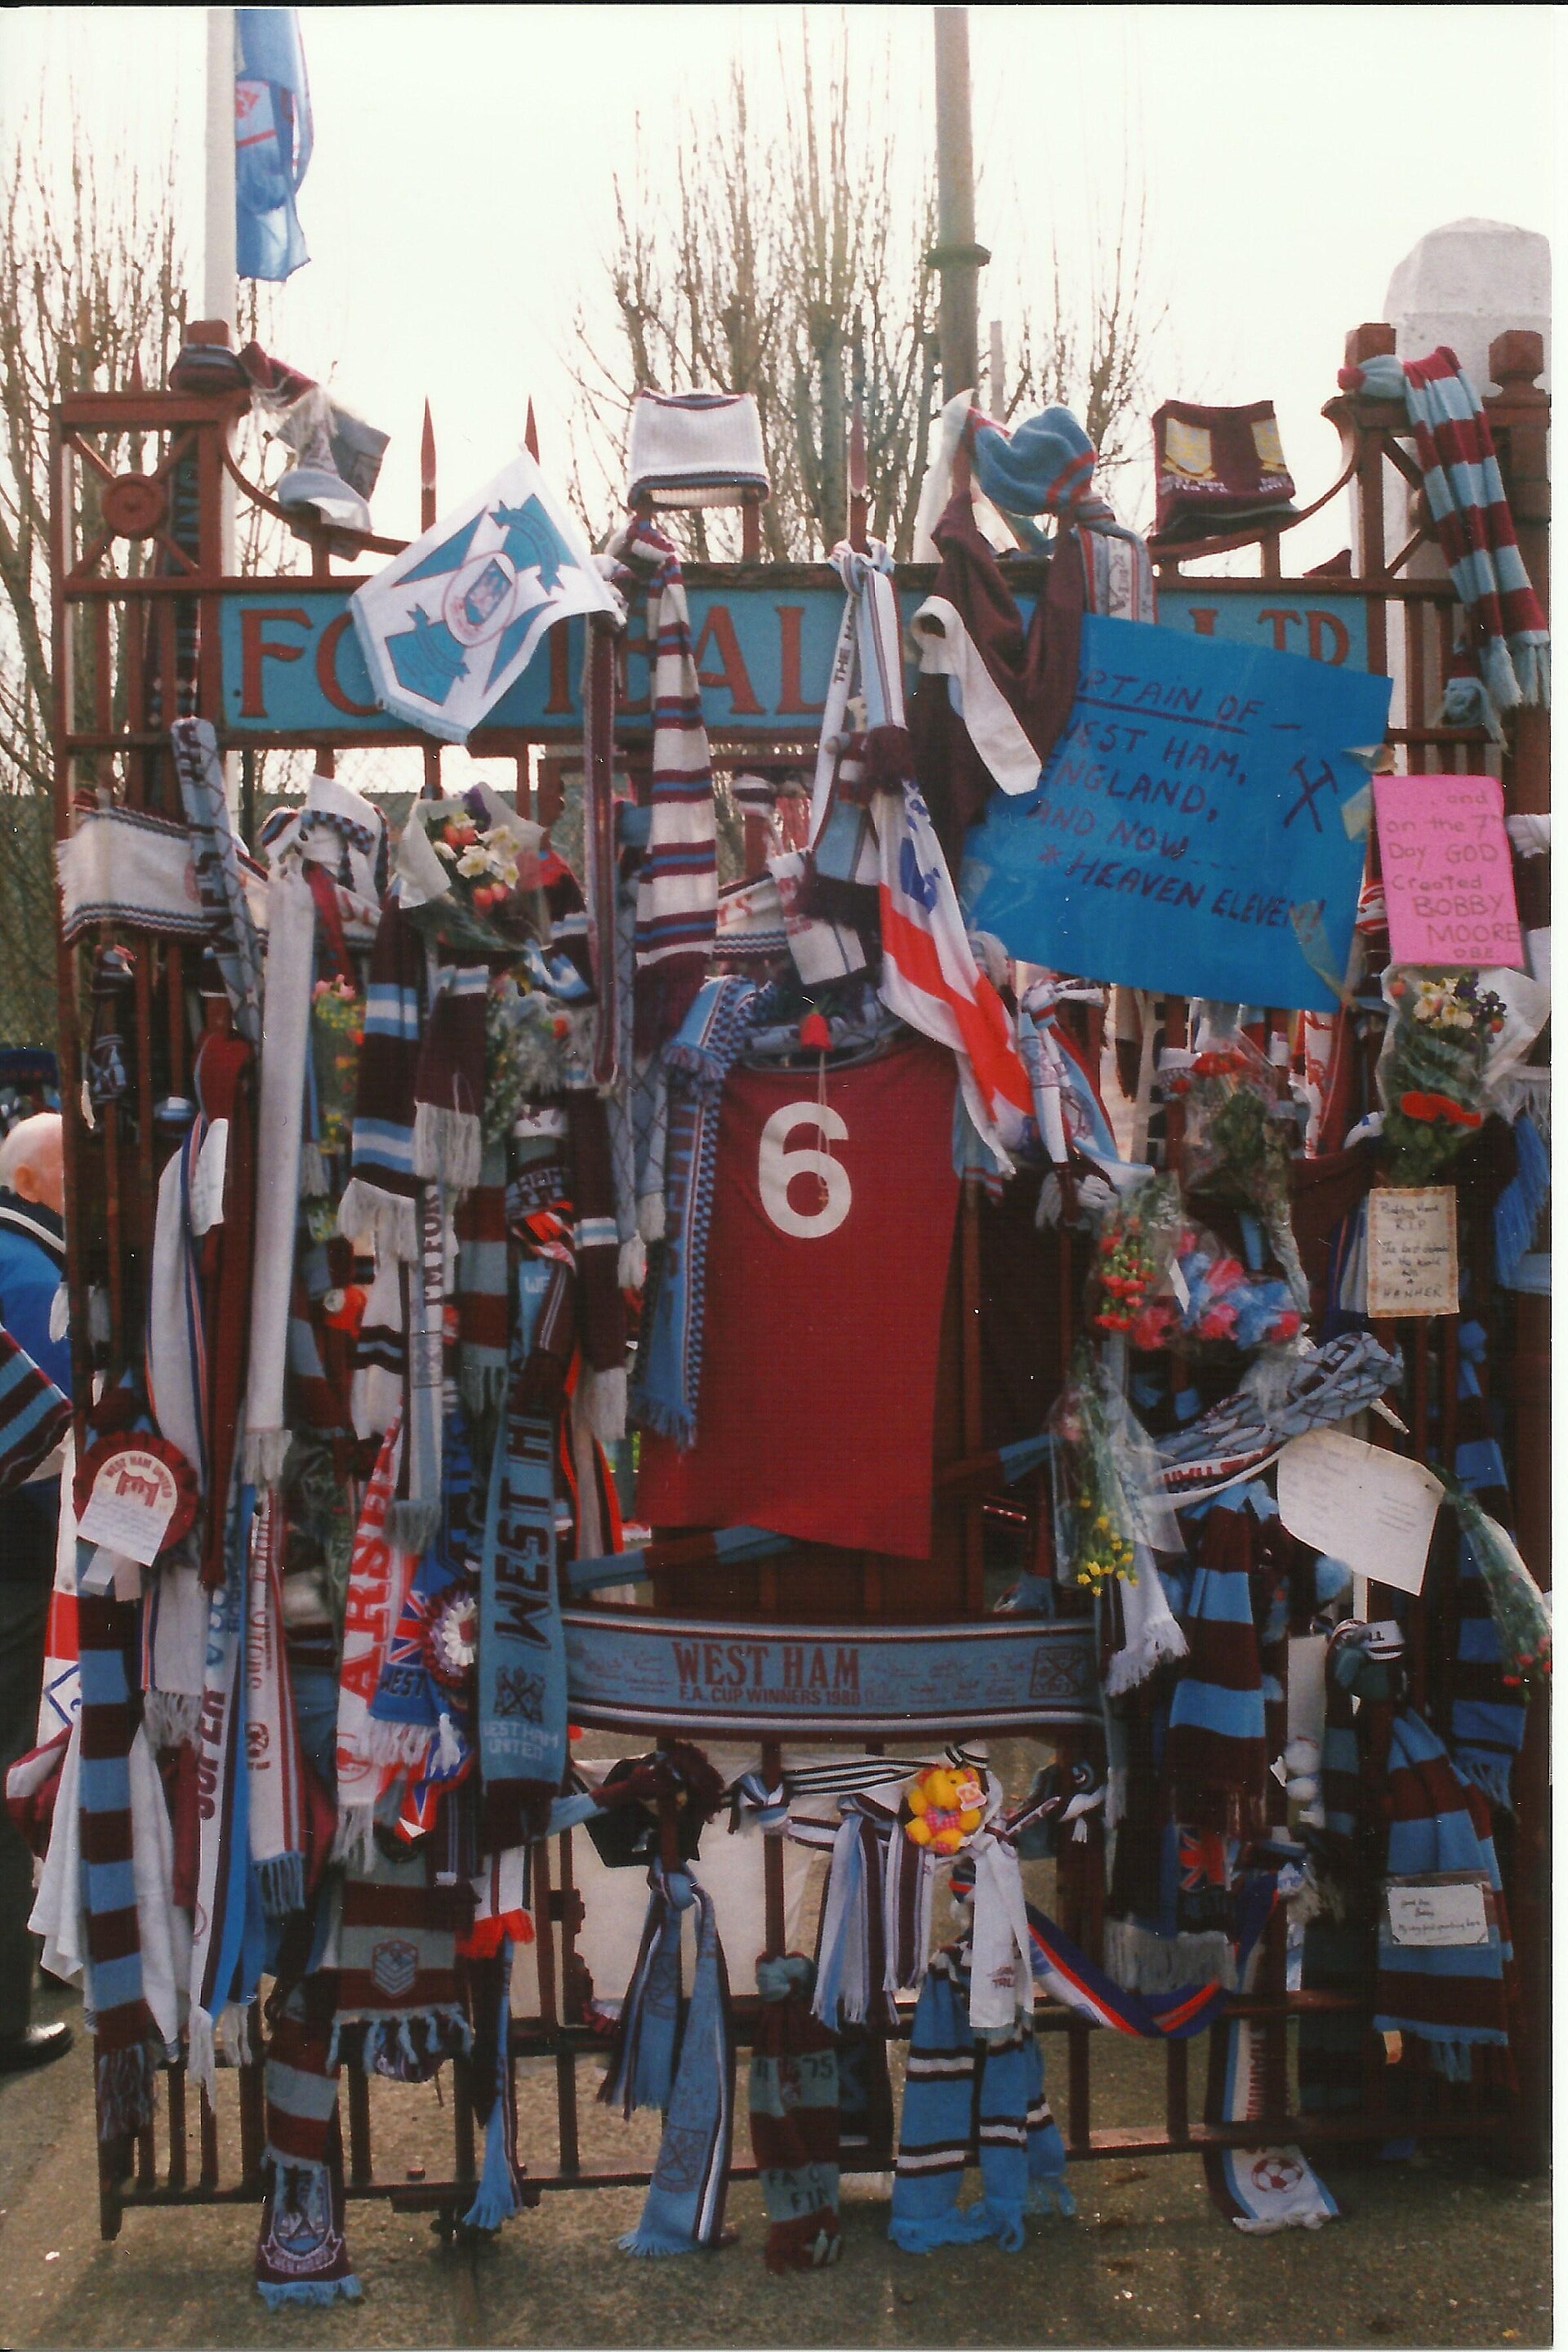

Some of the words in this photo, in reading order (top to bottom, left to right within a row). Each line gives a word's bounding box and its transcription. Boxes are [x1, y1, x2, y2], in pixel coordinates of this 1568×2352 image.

[1080, 668, 1203, 714] PTAIN
[1217, 695, 1266, 724] OF
[1163, 737, 1246, 786] HAM,
[1027, 798, 1097, 837] AND
[1388, 821, 1417, 834] on
[1426, 817, 1465, 833] the
[1389, 842, 1428, 871] Day
[1446, 843, 1499, 865] GOD
[1064, 851, 1206, 910] HEAVEN
[1412, 893, 1505, 919] BOBBY
[1426, 923, 1519, 946] MOORE
[1452, 946, 1494, 959] OBE
[758, 1101, 852, 1239] 6
[129, 1455, 153, 1469] HAM
[494, 1477, 553, 1650] WEST
[670, 1641, 770, 1687] WEST
[782, 1645, 860, 1690] HAM
[710, 1687, 744, 1704] CUP
[746, 1688, 822, 1707] WINNERS
[826, 1689, 862, 1707] 1980
